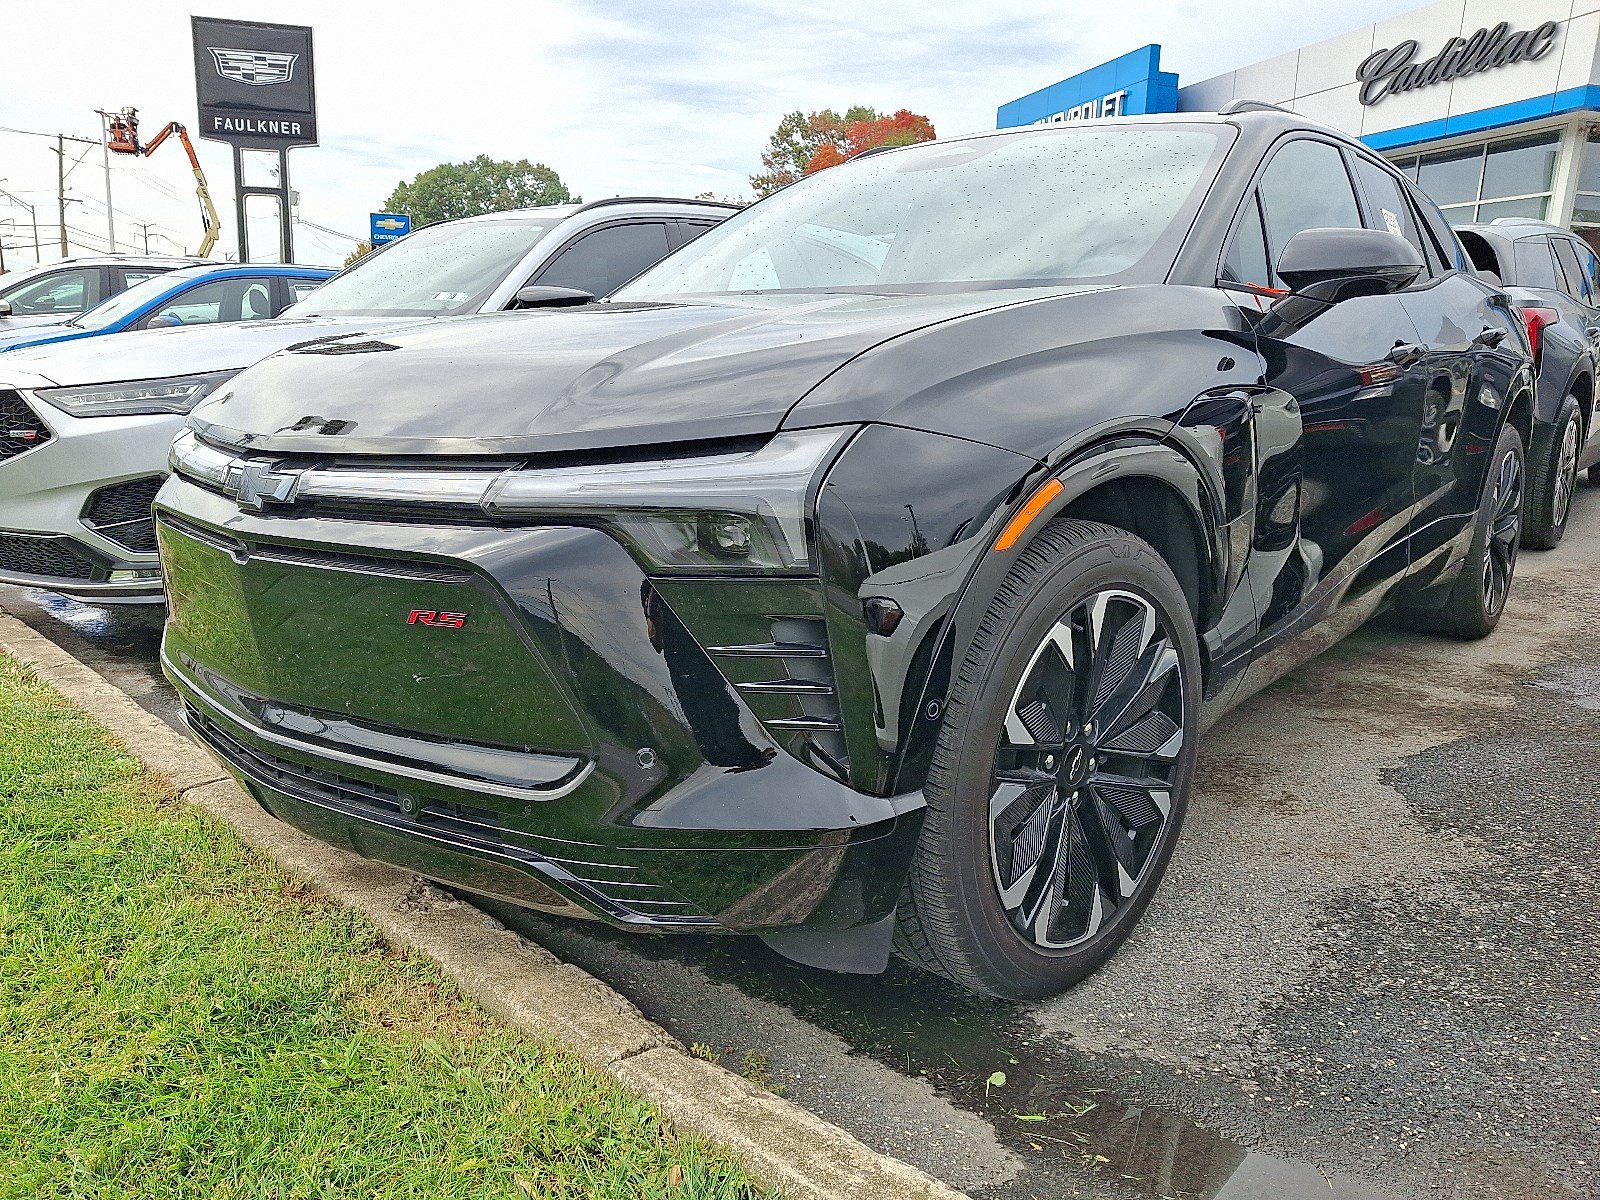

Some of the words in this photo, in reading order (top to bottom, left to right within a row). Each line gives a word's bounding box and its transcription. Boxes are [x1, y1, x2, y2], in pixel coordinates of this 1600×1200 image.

[1356, 21, 1556, 105] Cadillac
[214, 117, 302, 135] FAULKNER
[407, 609, 468, 628] RS
